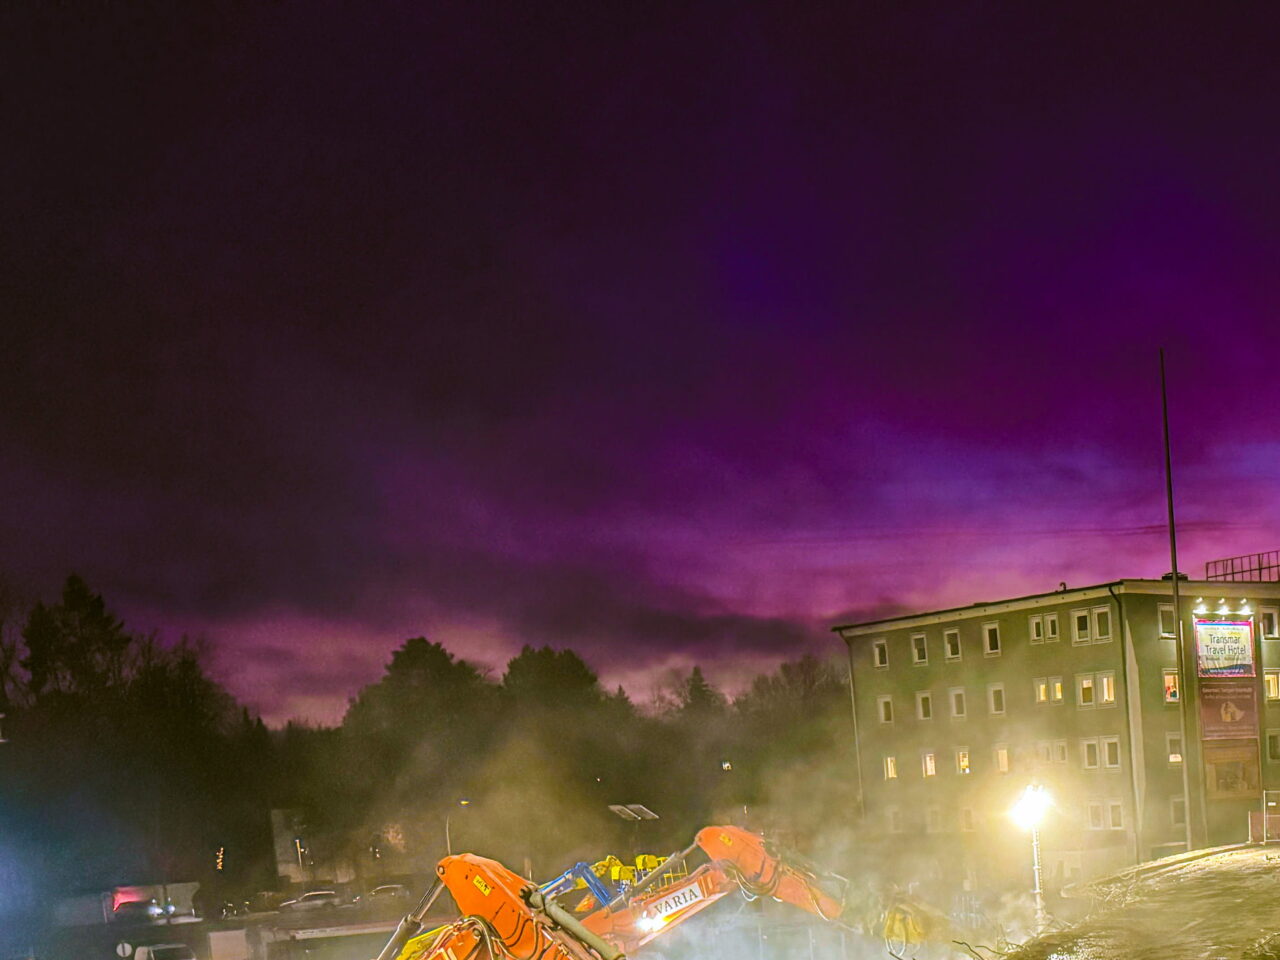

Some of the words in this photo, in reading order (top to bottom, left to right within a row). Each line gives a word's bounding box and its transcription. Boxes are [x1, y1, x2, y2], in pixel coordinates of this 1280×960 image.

[1205, 645, 1226, 655] Travel
[1227, 645, 1247, 655] Hotel
[654, 888, 699, 914] VARIA
